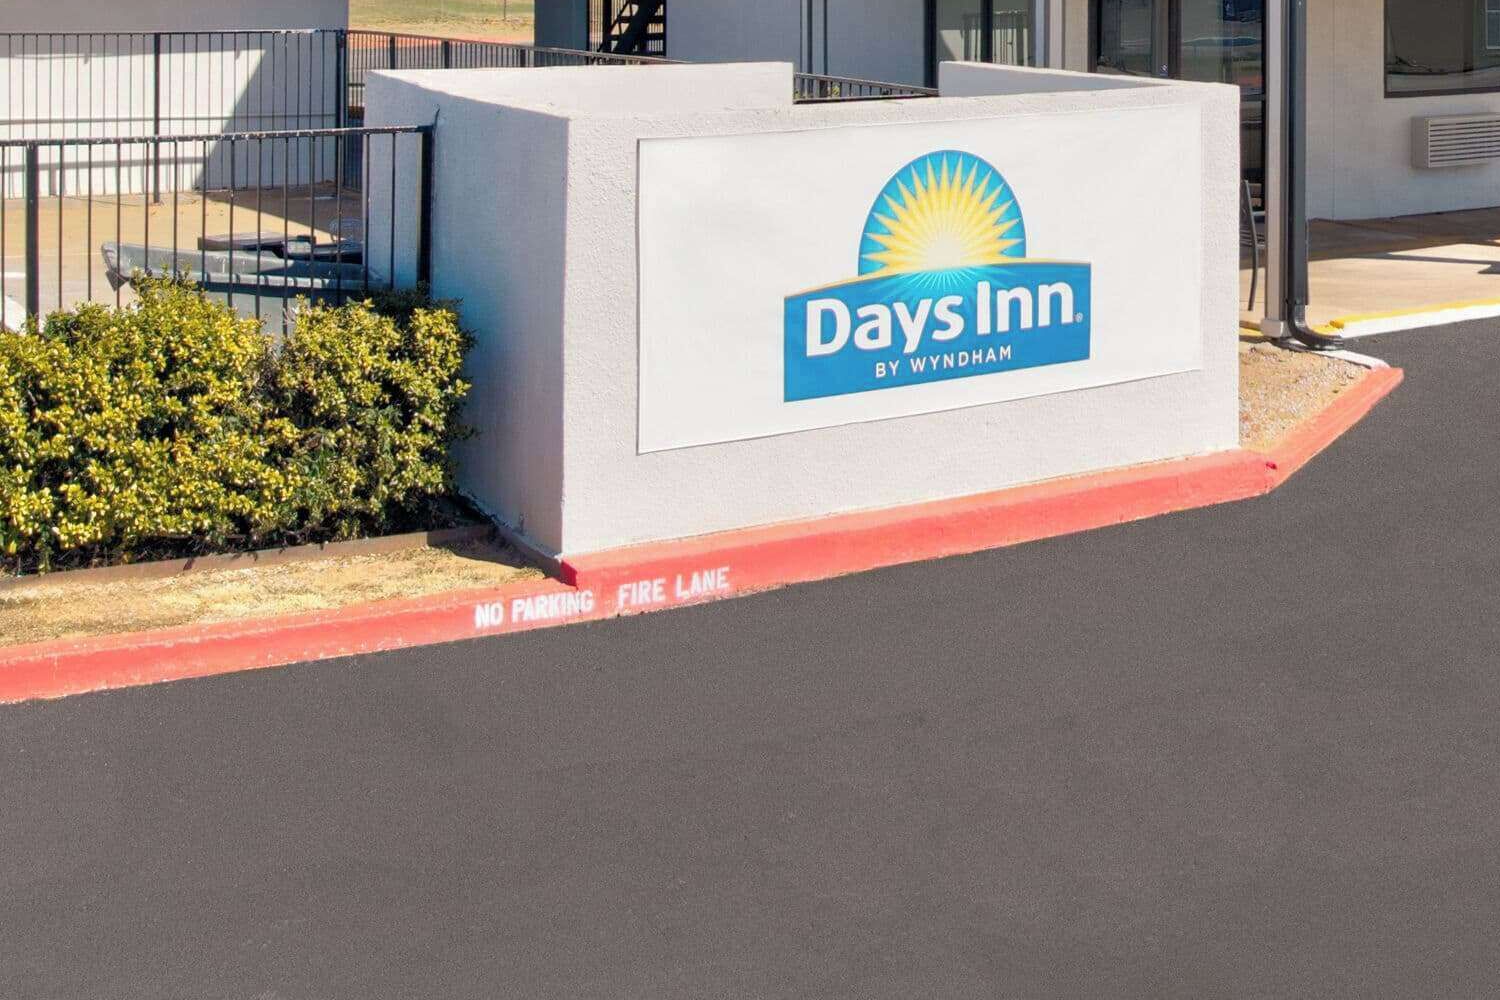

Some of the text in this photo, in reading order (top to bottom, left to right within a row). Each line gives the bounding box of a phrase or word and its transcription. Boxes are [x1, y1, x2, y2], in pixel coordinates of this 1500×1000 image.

[806, 281, 1075, 354] Days Inn
[875, 345, 1012, 378] BY WYNDHAM
[474, 566, 731, 629] NO PARKING FIRE LANE
